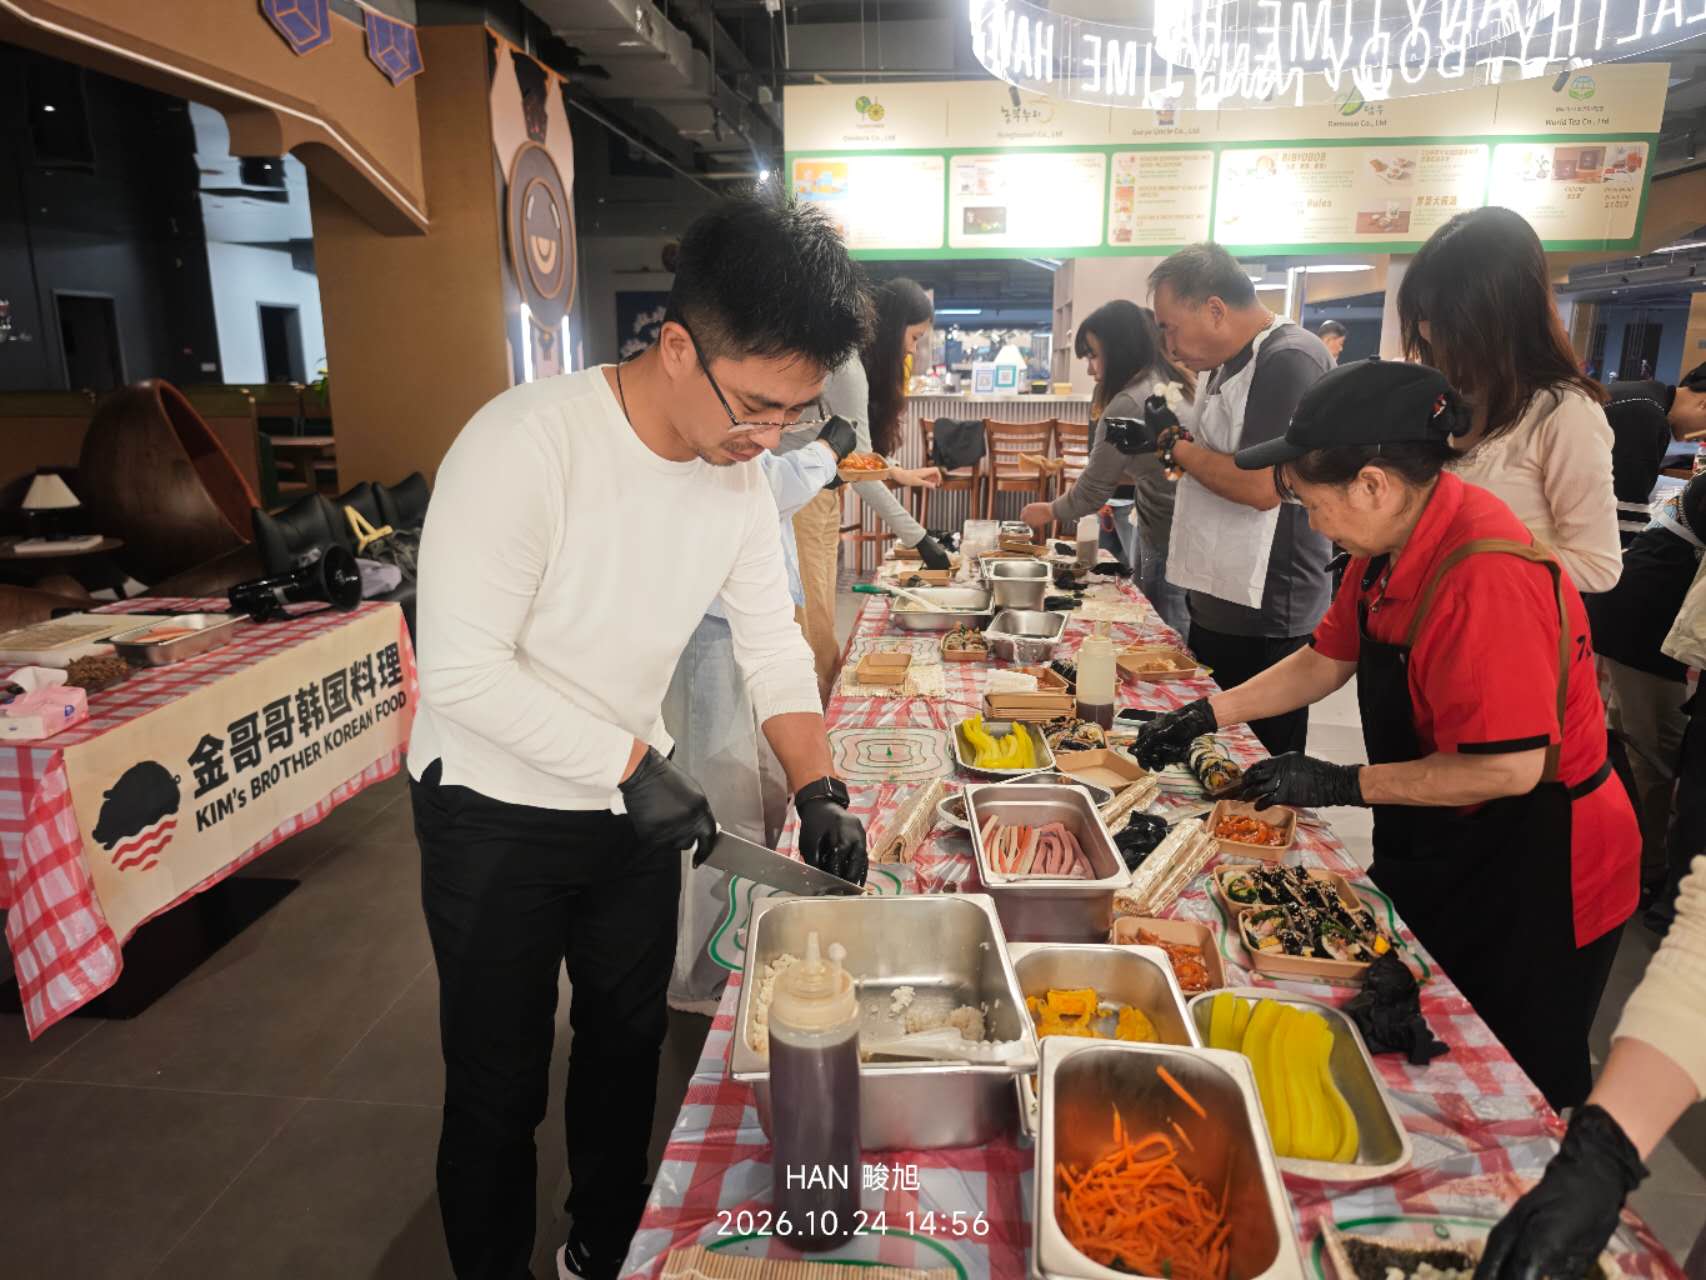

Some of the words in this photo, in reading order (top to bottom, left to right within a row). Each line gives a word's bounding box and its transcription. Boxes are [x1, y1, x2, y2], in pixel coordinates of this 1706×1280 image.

[187, 641, 404, 799] 金哥哥韩国料理
[194, 787, 247, 833] KIM's
[250, 741, 322, 798] BROTHER
[323, 712, 374, 753] KOREAN
[374, 690, 407, 721] FOOD
